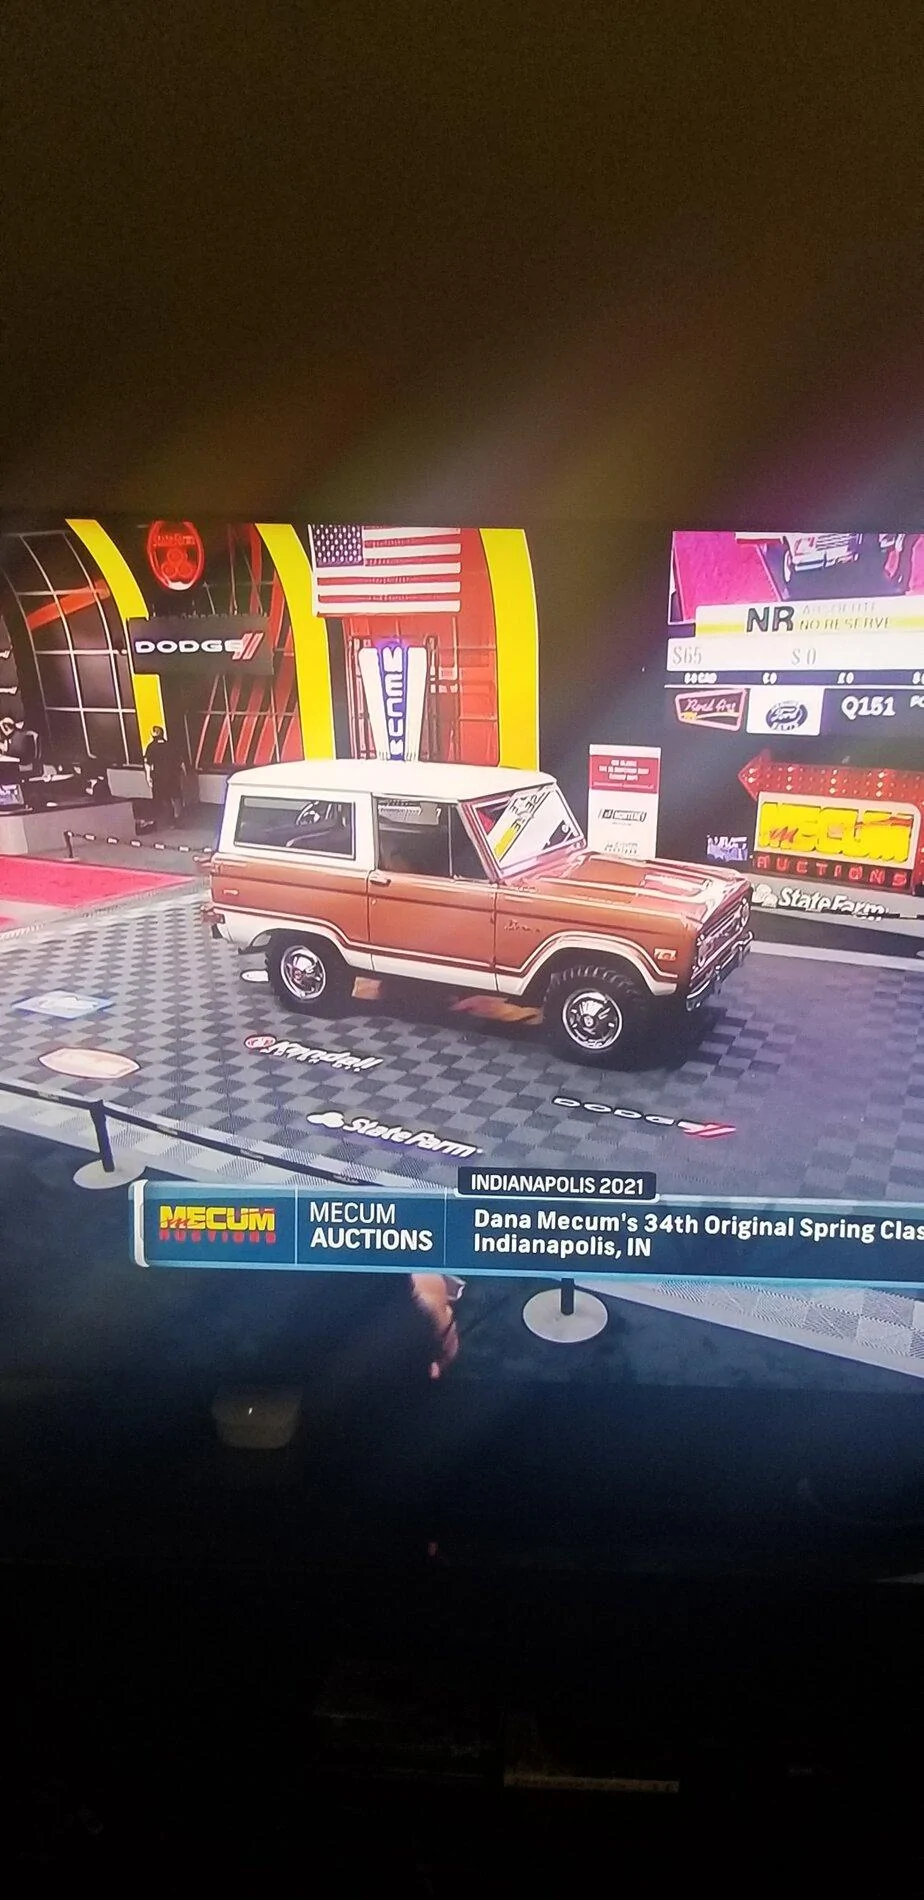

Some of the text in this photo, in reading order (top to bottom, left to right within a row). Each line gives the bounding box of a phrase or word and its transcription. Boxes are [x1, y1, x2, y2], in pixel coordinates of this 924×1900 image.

[746, 606, 795, 632] NR
[134, 639, 243, 654] DODGE
[381, 646, 406, 758] MECUM
[841, 695, 896, 720] Q151
[758, 801, 914, 864] MECUM
[756, 855, 908, 887] AUCTIONS
[471, 1173, 644, 1195] INDIANAPOLIS 2021
[159, 1205, 276, 1232] MECUM
[309, 1202, 396, 1224] MECUM
[474, 1208, 924, 1244] Dana Mecum's 34th Original Spring Clas
[309, 1228, 433, 1252] AUCTIONS
[473, 1233, 652, 1260] Indianapolis, IN
